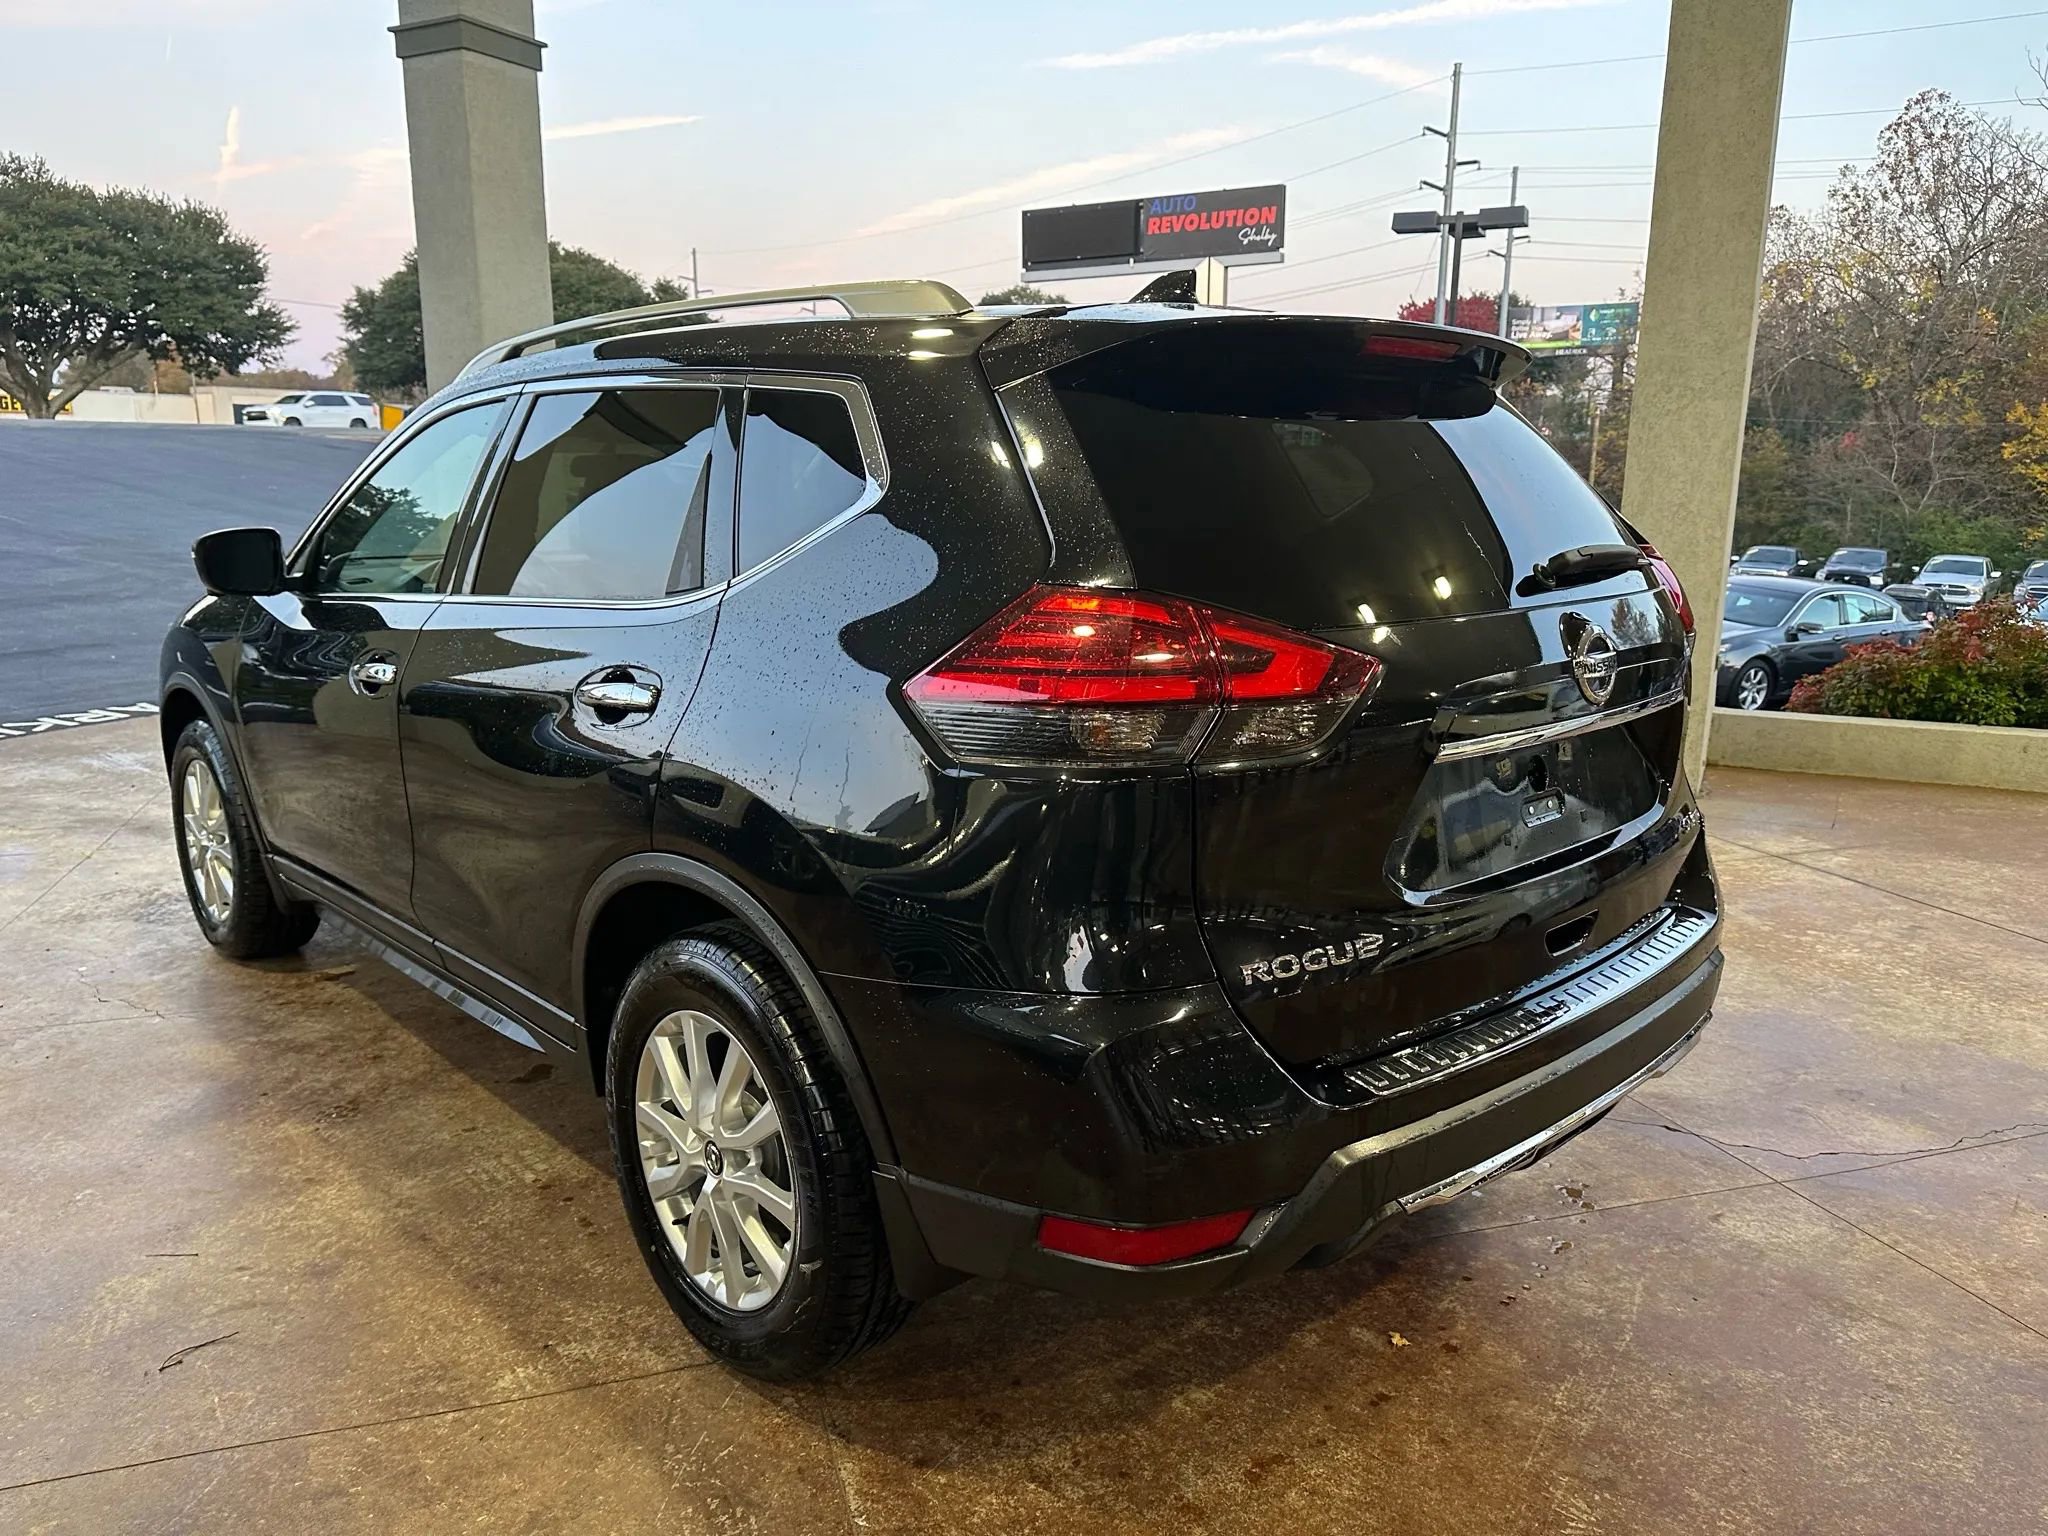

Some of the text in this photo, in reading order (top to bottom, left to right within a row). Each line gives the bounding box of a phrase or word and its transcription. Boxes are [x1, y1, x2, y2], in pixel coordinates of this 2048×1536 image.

[1150, 195, 1197, 214] AUTO
[1147, 206, 1278, 235] REVOLUTION
[1238, 225, 1278, 247] Shelby
[1239, 932, 1384, 986] ROGUE
